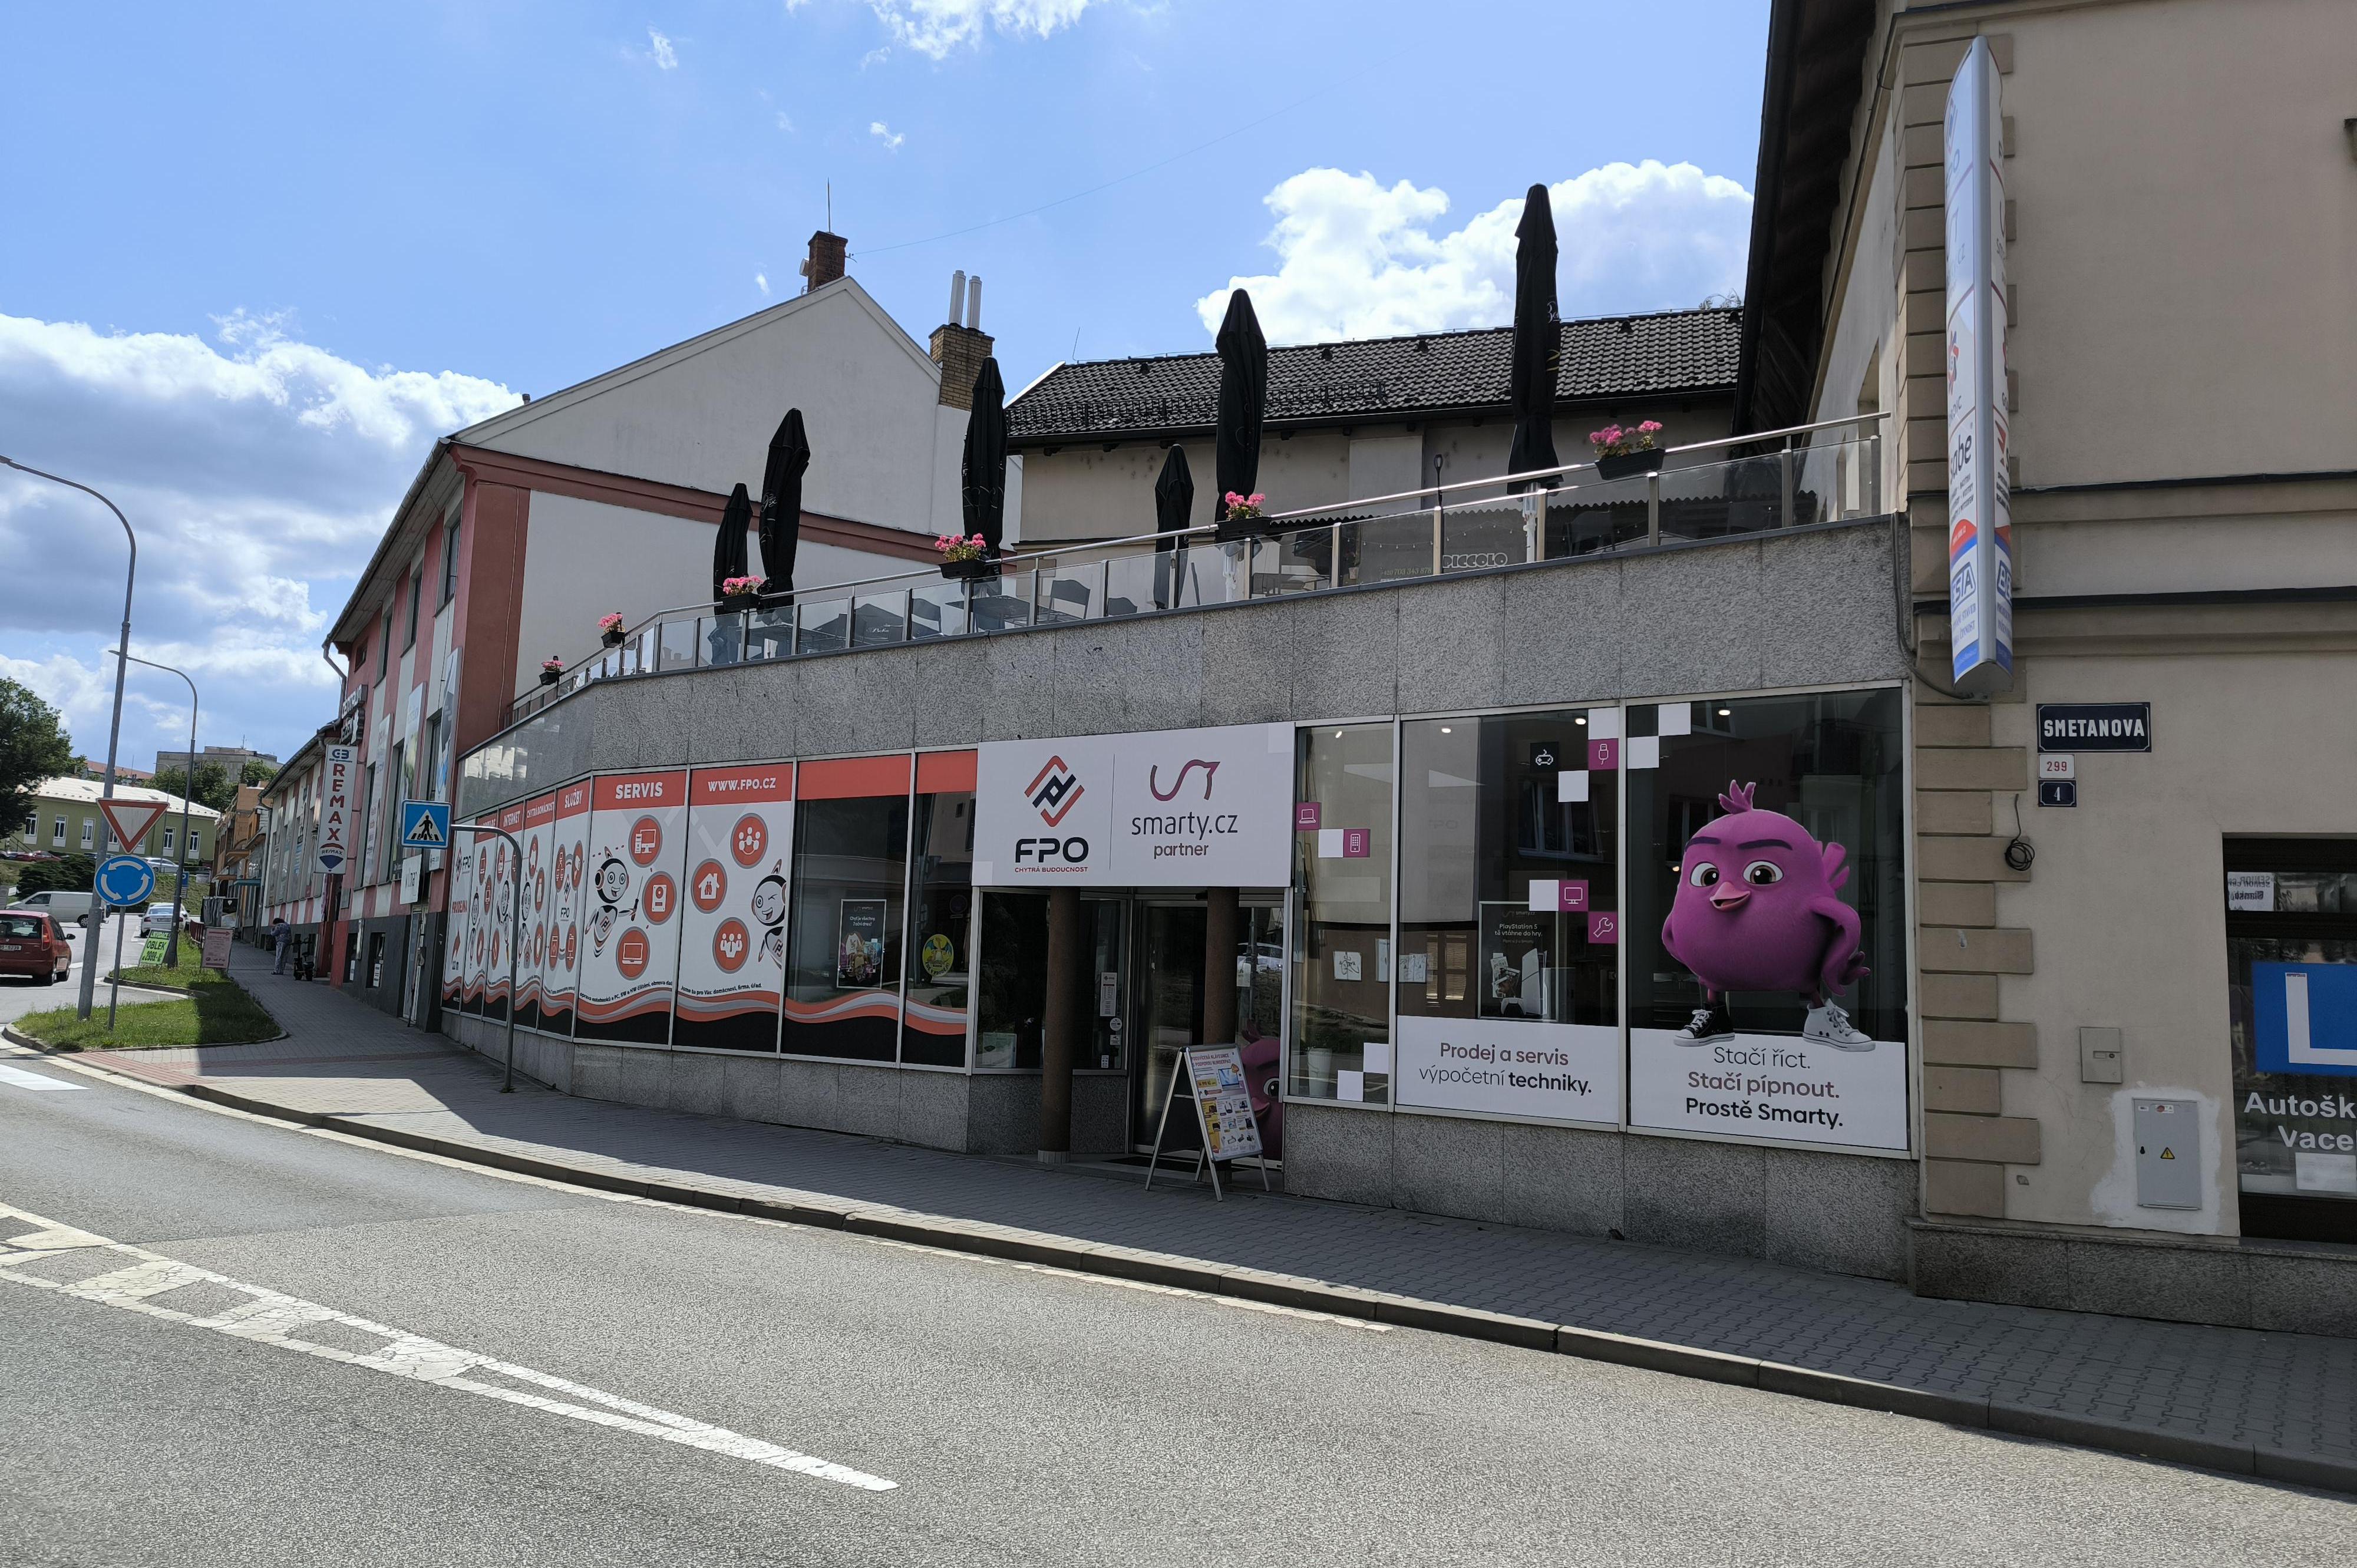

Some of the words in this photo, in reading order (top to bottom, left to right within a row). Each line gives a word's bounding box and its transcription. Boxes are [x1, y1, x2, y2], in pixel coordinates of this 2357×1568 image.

[1442, 552, 1508, 569] PICCOLO
[2044, 719, 2145, 737] SMETANOVA
[2047, 761, 2067, 771] 299
[615, 782, 663, 800] SERVIS
[708, 777, 776, 792] WWW.FPO.CZ
[327, 763, 345, 841] REMAX
[565, 788, 583, 808] SLUŽBY
[2054, 787, 2061, 801] 4
[503, 810, 521, 827] INTERNET
[1131, 811, 1238, 840] smarty.cz
[1015, 837, 1089, 863] FPO
[1154, 843, 1209, 859] partner
[462, 856, 471, 870] FPO
[452, 900, 467, 913] PRODEJNA
[560, 907, 570, 918] FPO
[147, 941, 166, 950] OBLEK
[580, 992, 592, 1001] oprava
[713, 986, 737, 994] domácnost,
[1440, 1042, 1496, 1064] Prodej
[1500, 1049, 1511, 1062] a
[1516, 1048, 1569, 1066] servis
[1714, 1047, 1767, 1066] Stačí
[1772, 1048, 1811, 1069] říct.
[1419, 1064, 1505, 1085] výpočetní
[1508, 1072, 1592, 1096] techniky.
[1688, 1071, 1742, 1091] Stačí
[1747, 1074, 1840, 1098] pípnout.
[1686, 1098, 1752, 1119] Prostě
[1758, 1103, 1843, 1130] Smarty.
[2244, 1092, 2356, 1119] Autošk
[2278, 1125, 2357, 1151] Vace
